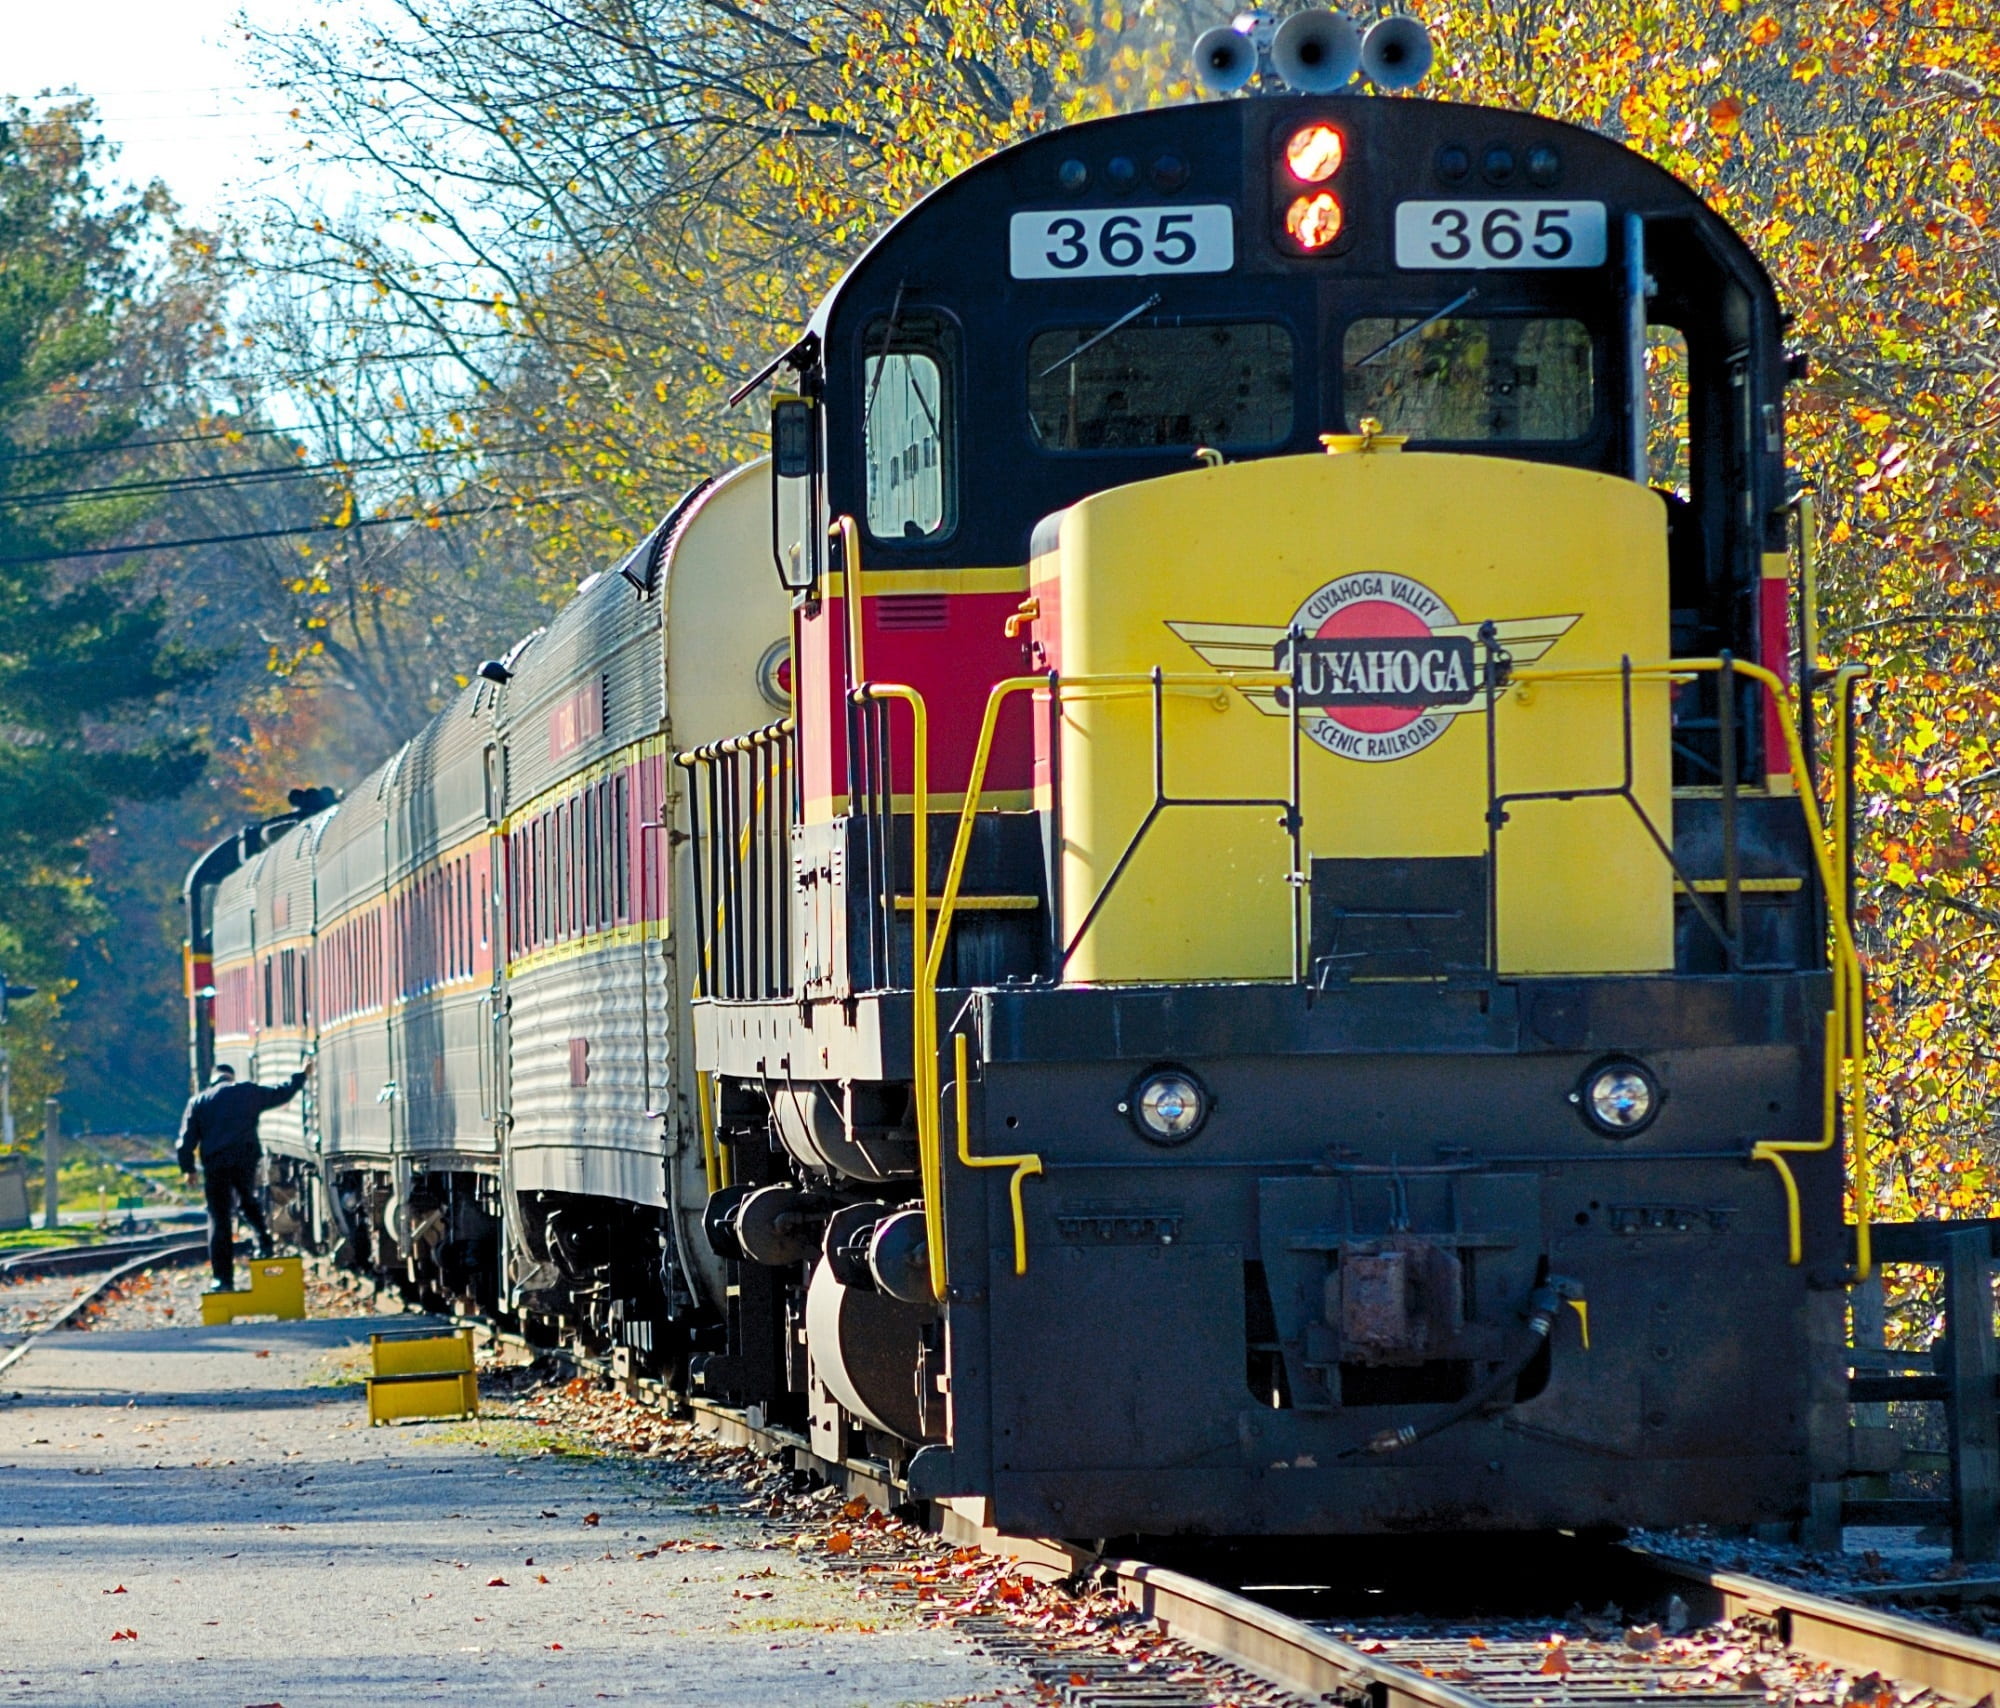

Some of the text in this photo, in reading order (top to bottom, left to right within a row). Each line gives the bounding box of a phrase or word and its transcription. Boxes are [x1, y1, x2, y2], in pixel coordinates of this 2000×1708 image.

[1044, 214, 1198, 270] 365
[1430, 208, 1573, 261] 365
[1307, 578, 1440, 619] CUYAHOGA VALLEY
[1313, 717, 1438, 756] SCENIC RAILROAD
